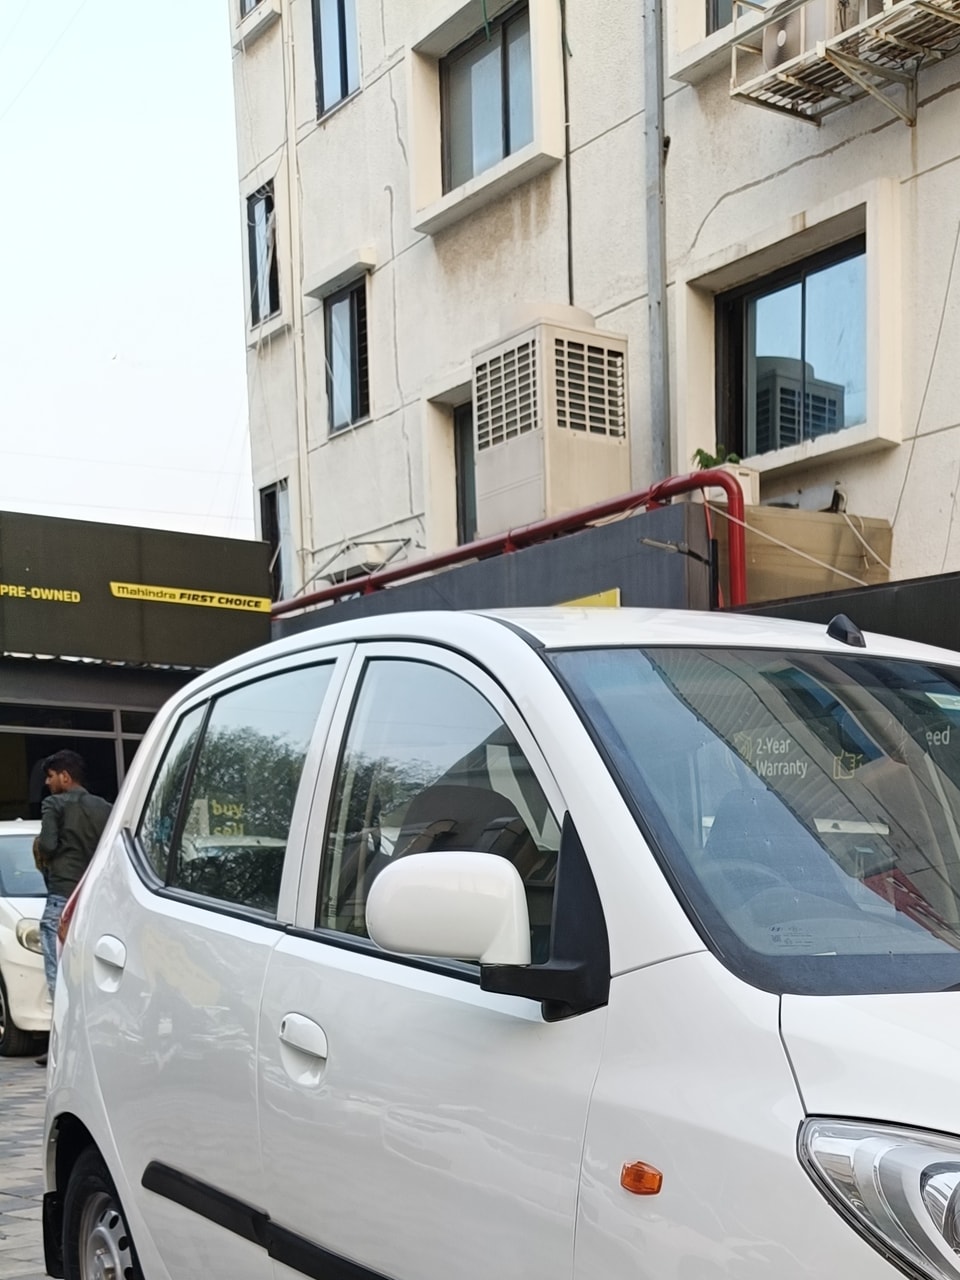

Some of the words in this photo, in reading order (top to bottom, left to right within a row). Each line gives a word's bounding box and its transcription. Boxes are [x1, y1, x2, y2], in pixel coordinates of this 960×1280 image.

[0, 584, 81, 603] PRE-OWNED
[117, 585, 177, 600] Mahindra
[179, 592, 217, 604] FIRST
[217, 596, 262, 609] CHOICE
[755, 738, 791, 754] 2-Year
[756, 760, 808, 778] Warranty
[211, 799, 245, 819] buy
